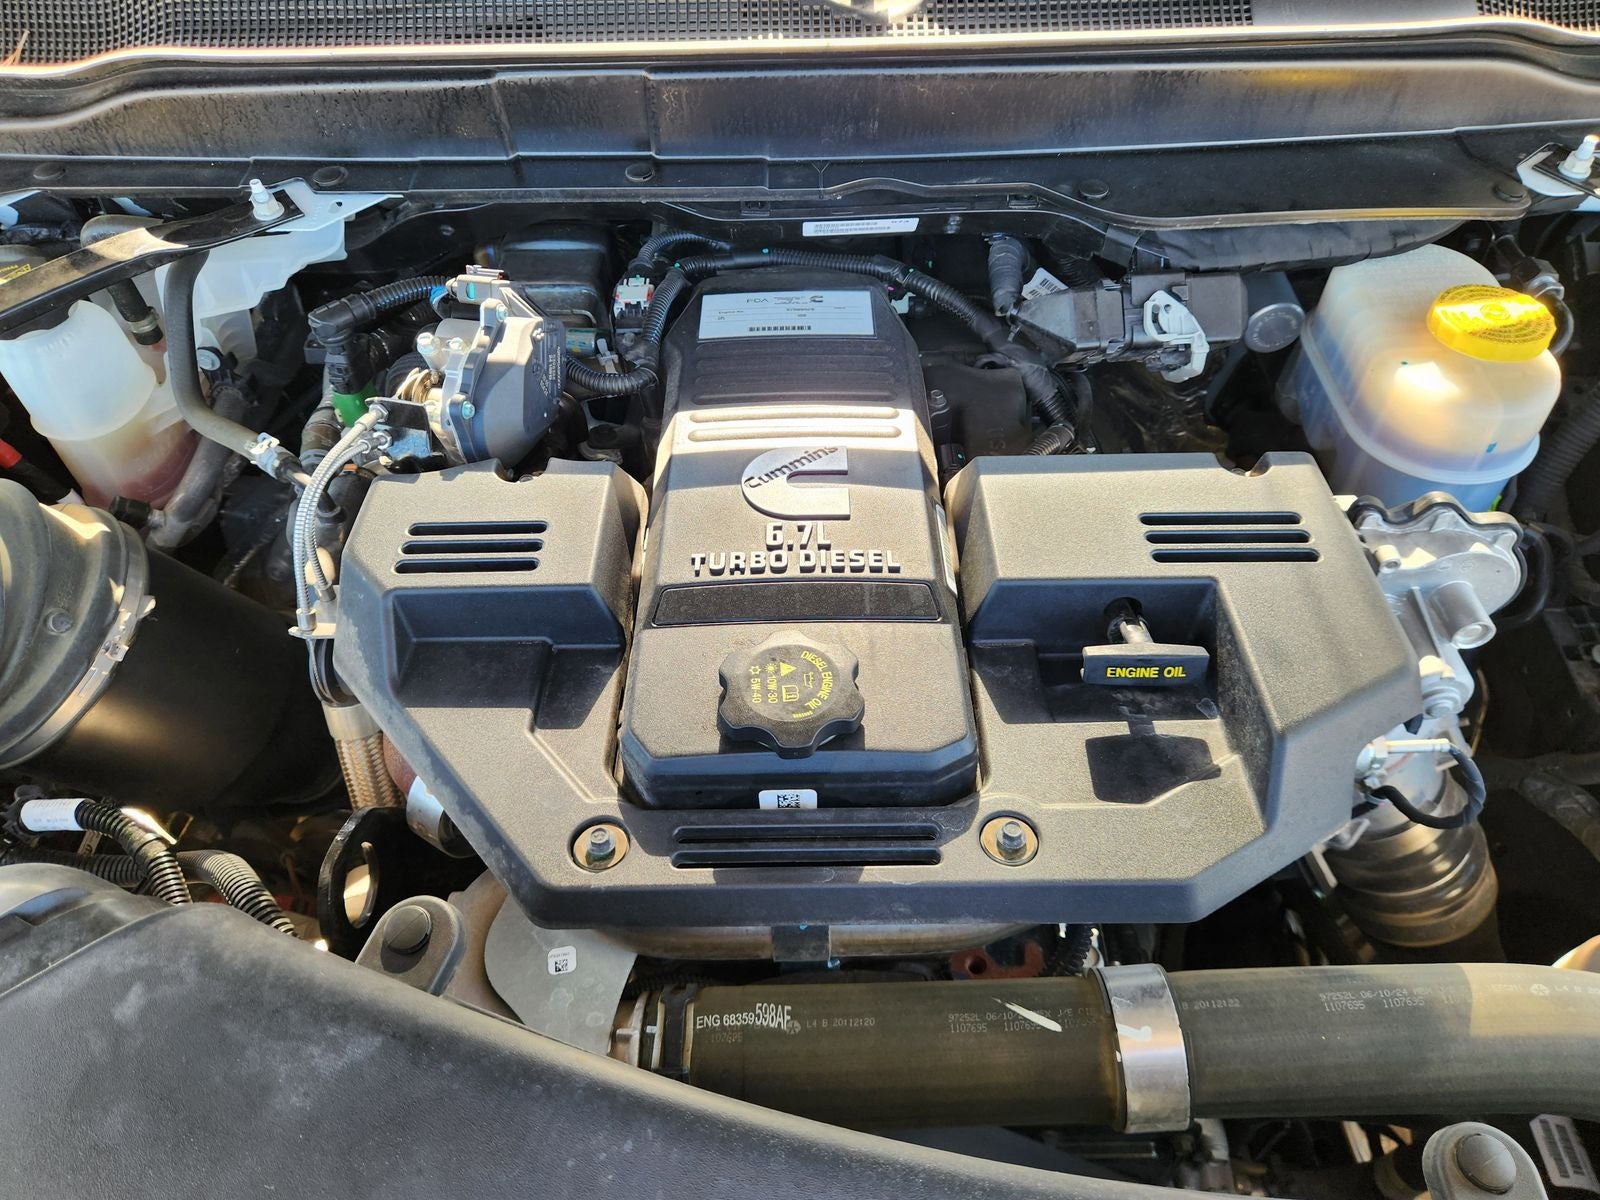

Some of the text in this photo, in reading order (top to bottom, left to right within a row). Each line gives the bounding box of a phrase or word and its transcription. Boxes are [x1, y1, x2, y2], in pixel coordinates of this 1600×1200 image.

[744, 446, 838, 488] Cummins
[765, 521, 832, 551] 6.7L
[691, 549, 901, 577] TURBO DIESEL
[801, 651, 833, 710] DIESEL ENGINE OIL
[1106, 666, 1187, 678] ENGINE OIL
[750, 678, 762, 704] 5W-40
[766, 674, 778, 704] 10W-30
[696, 1015, 721, 1029] ENG
[948, 1013, 981, 1022] 97252L
[986, 1011, 1030, 1021] 06/10/2
[949, 1023, 988, 1033] 1107695
